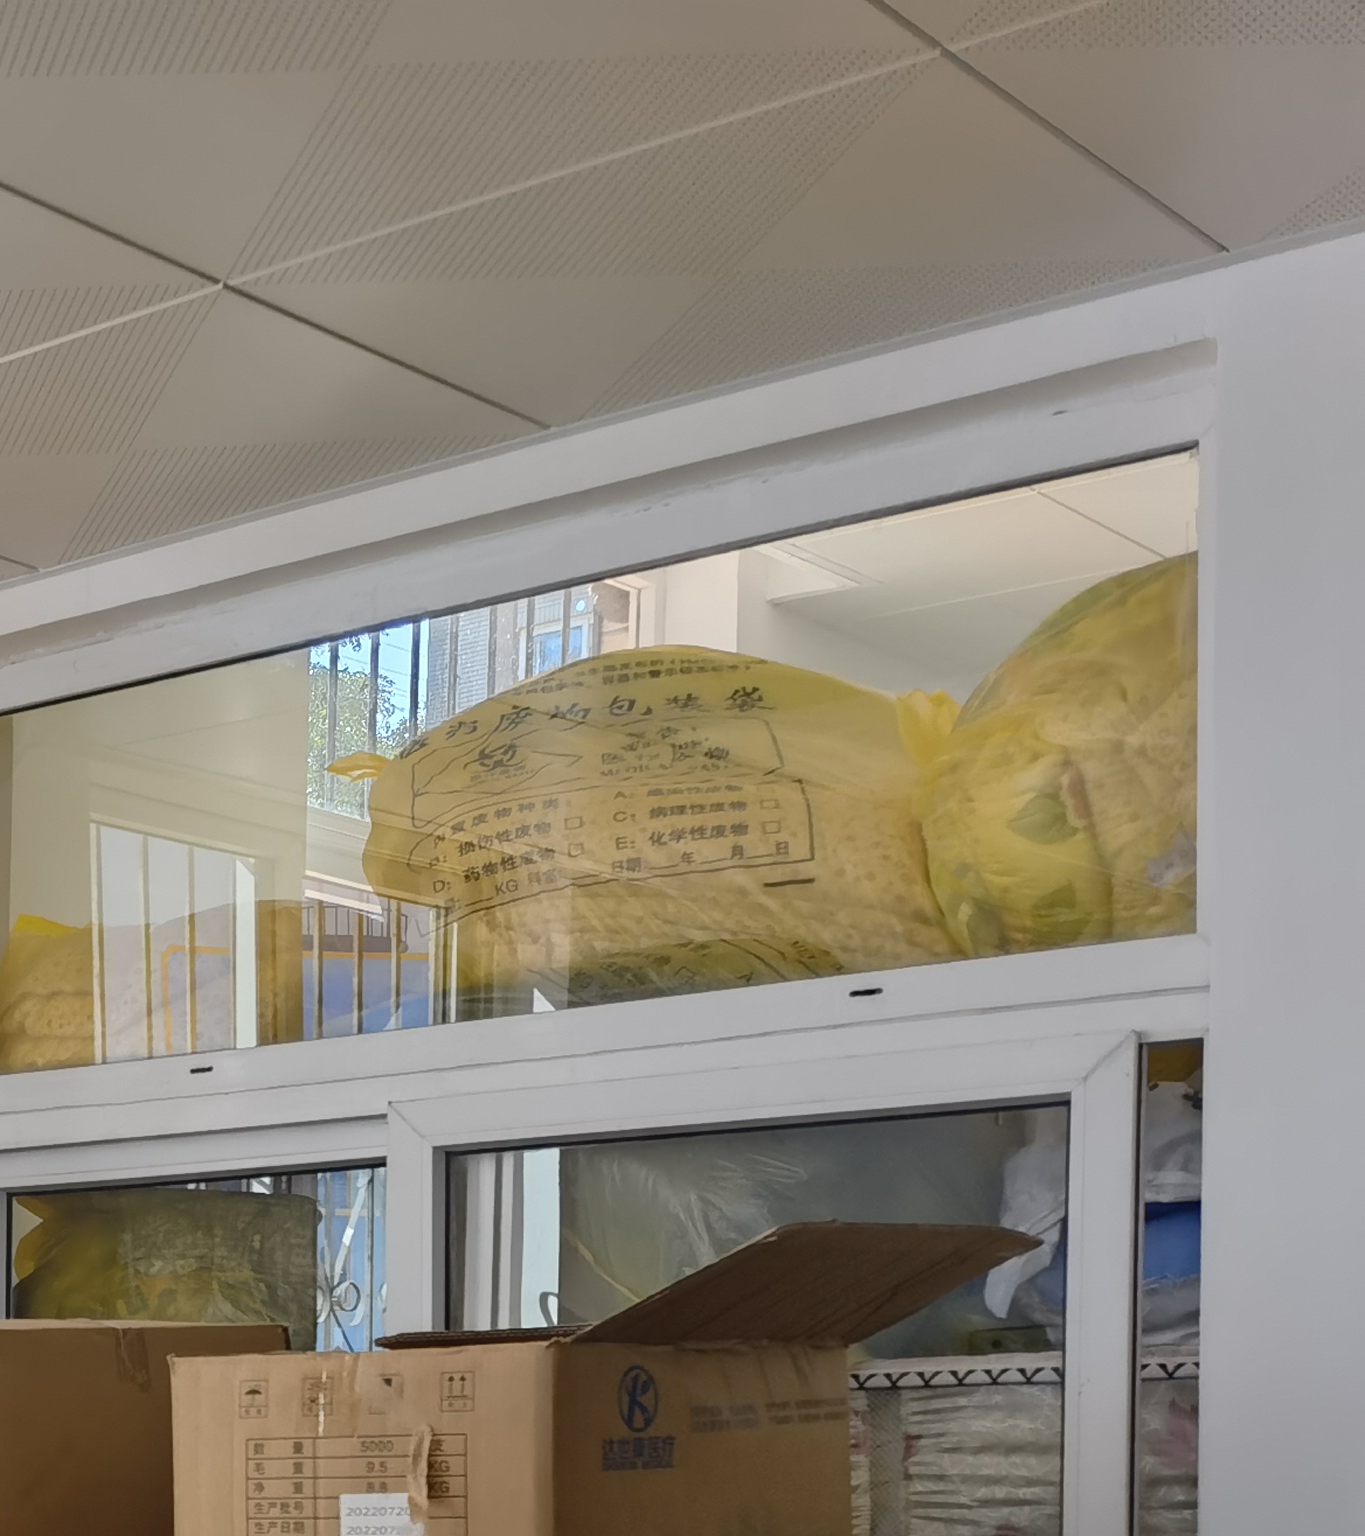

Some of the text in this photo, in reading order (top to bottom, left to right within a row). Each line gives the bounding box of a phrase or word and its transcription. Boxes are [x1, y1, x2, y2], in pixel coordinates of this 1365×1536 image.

[648, 823, 749, 847] 化学性废物
[494, 880, 519, 895] KG
[365, 1460, 388, 1474] 9.5
